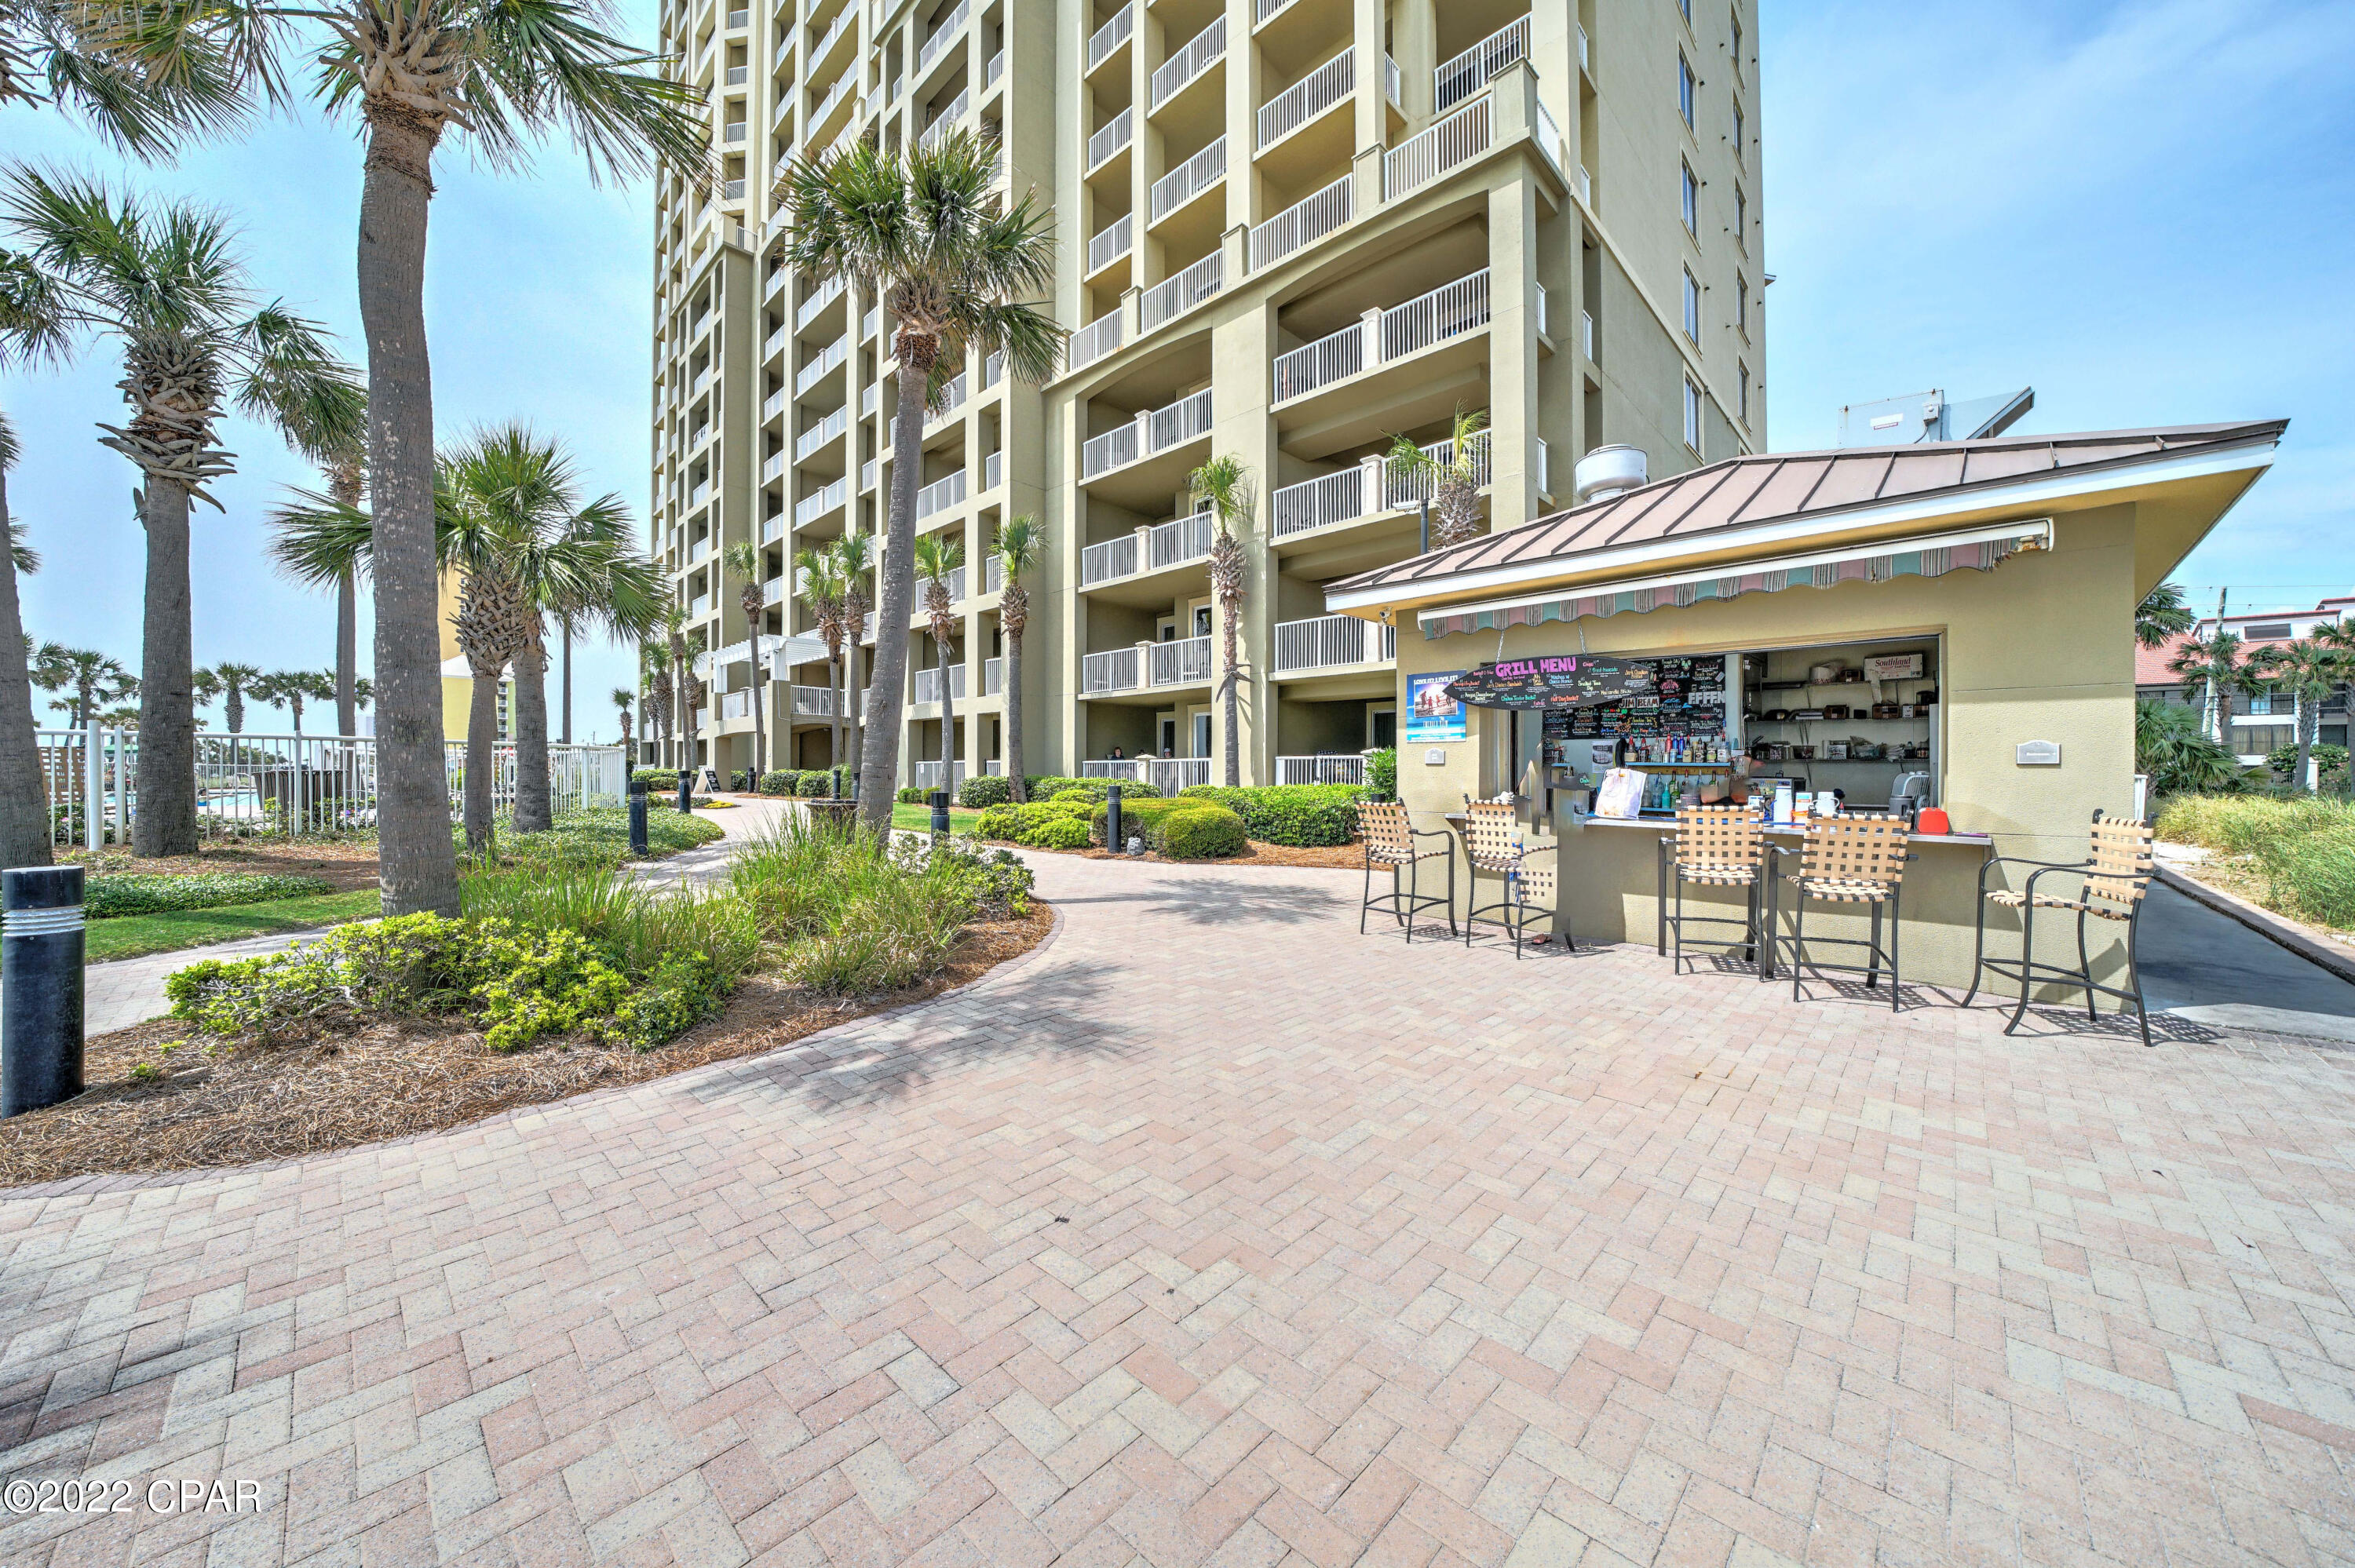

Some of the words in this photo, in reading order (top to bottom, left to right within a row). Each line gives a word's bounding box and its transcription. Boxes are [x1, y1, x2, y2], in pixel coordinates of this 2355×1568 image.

[1495, 660, 1538, 678] GRILL
[1539, 656, 1576, 673] MENU
[1875, 657, 1911, 667] Southland
[1619, 698, 1636, 708] JIM
[1637, 696, 1659, 708] BEAM
